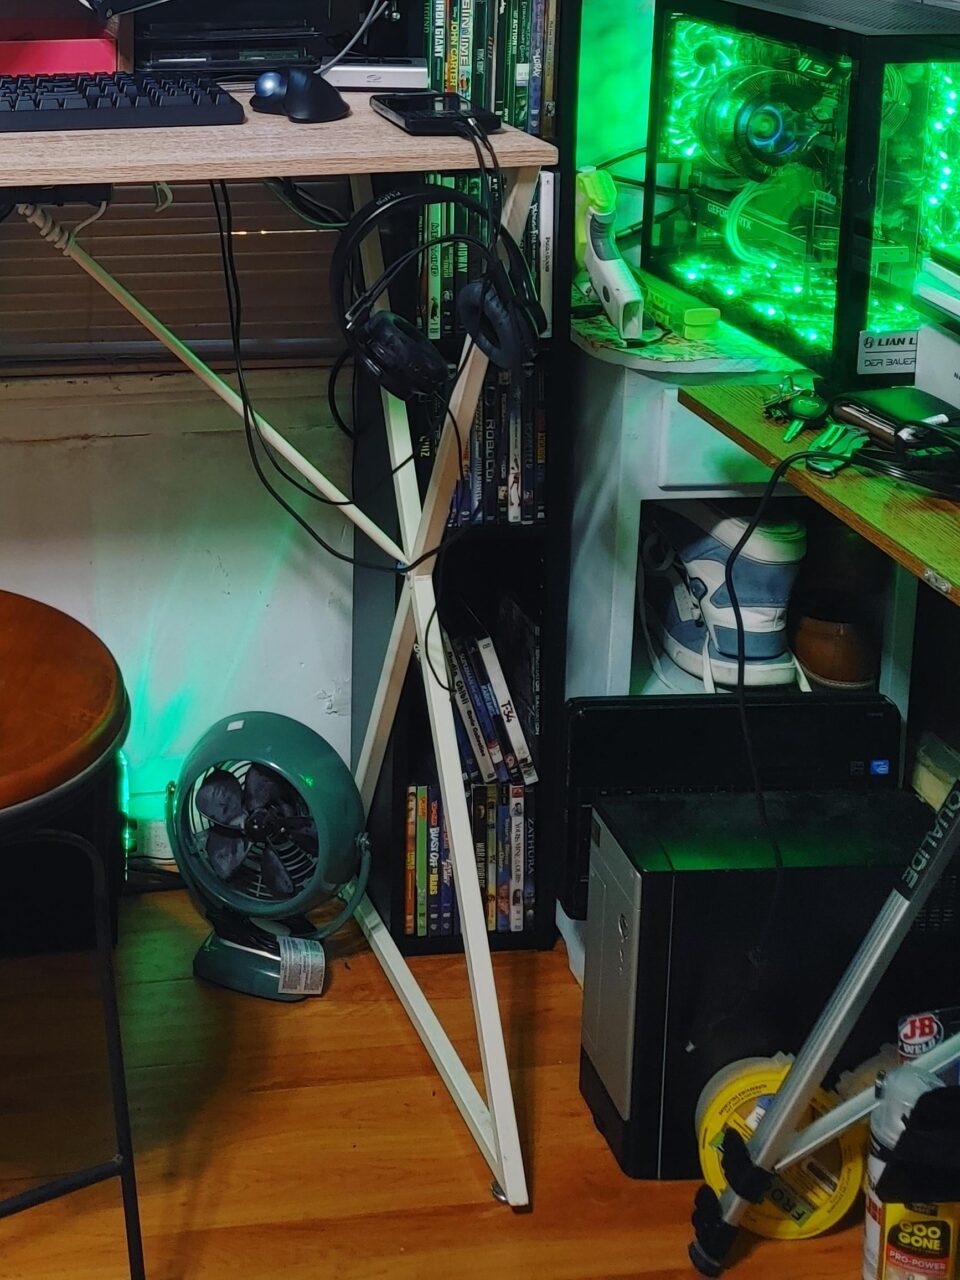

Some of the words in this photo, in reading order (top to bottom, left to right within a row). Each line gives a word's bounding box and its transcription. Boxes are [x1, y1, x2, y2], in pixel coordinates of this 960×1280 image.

[435, 0, 445, 26] IRON
[434, 27, 444, 58] GIANT
[450, 19, 458, 45] JOHN
[449, 47, 457, 86] CARTER
[532, 54, 542, 78] LORAX
[877, 336, 906, 347] LIAN
[864, 358, 884, 368] DER
[455, 680, 469, 706] Ghibli
[429, 827, 440, 852] BLAST
[475, 842, 485, 857] WAR
[527, 817, 535, 875] ZATHURA
[902, 1037, 937, 1056] WELD
[899, 1219, 942, 1239] GOO
[897, 1232, 942, 1251] GONE
[889, 1249, 947, 1271] PRO-POWER
